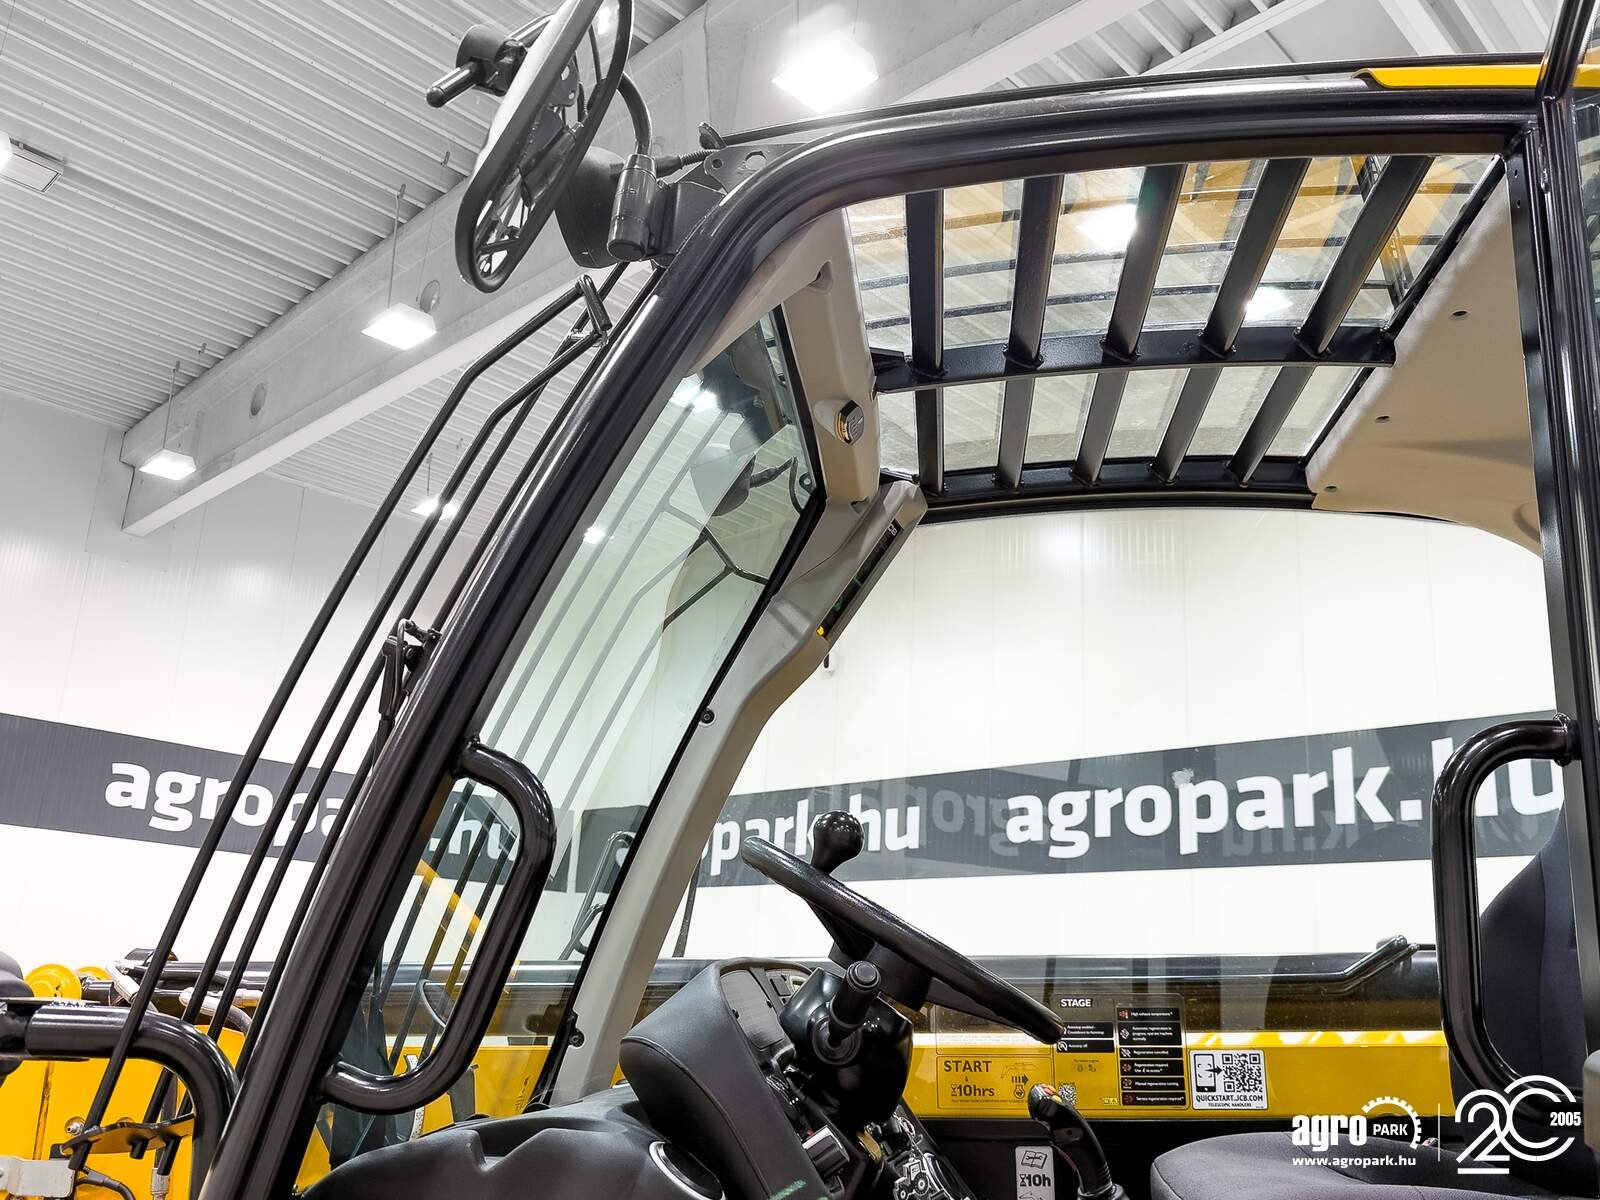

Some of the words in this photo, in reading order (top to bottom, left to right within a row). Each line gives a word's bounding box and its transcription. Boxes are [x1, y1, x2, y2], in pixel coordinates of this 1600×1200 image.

[1060, 998, 1092, 1008] STAGE
[943, 1060, 992, 1073] START
[957, 1084, 995, 1097] 10hrs
[1195, 1094, 1264, 1103] QUICKSTART.JCB.COM
[1026, 1173, 1052, 1187] 10h
